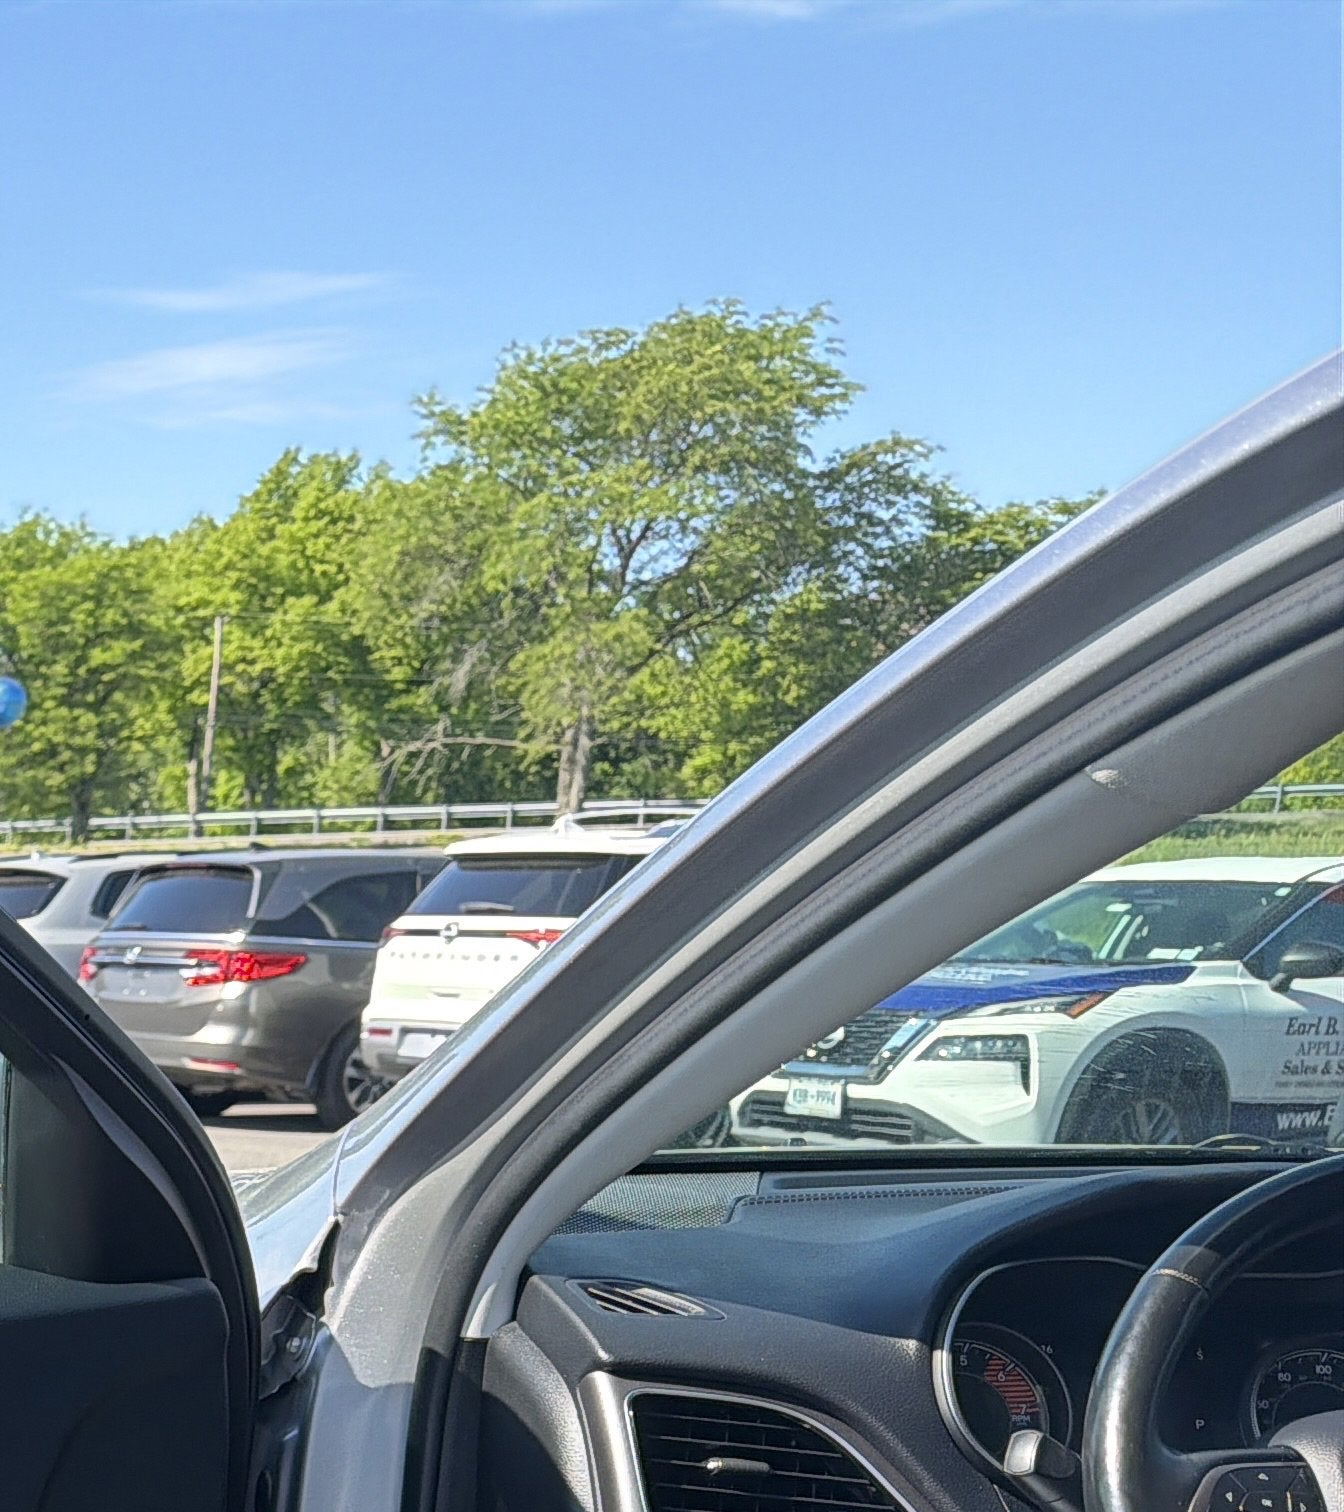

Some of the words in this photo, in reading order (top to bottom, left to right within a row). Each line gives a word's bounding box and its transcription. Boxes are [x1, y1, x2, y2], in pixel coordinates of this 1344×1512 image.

[1285, 1015, 1322, 1036] Earl
[1281, 1059, 1318, 1076] Sales
[1320, 1058, 1332, 1076] &
[959, 1355, 969, 1367] 5
[1315, 1364, 1333, 1375] 100
[997, 1371, 1006, 1382] 6
[1277, 1372, 1292, 1382] 80
[1018, 1403, 1028, 1415] 7
[1195, 1419, 1206, 1430] P
